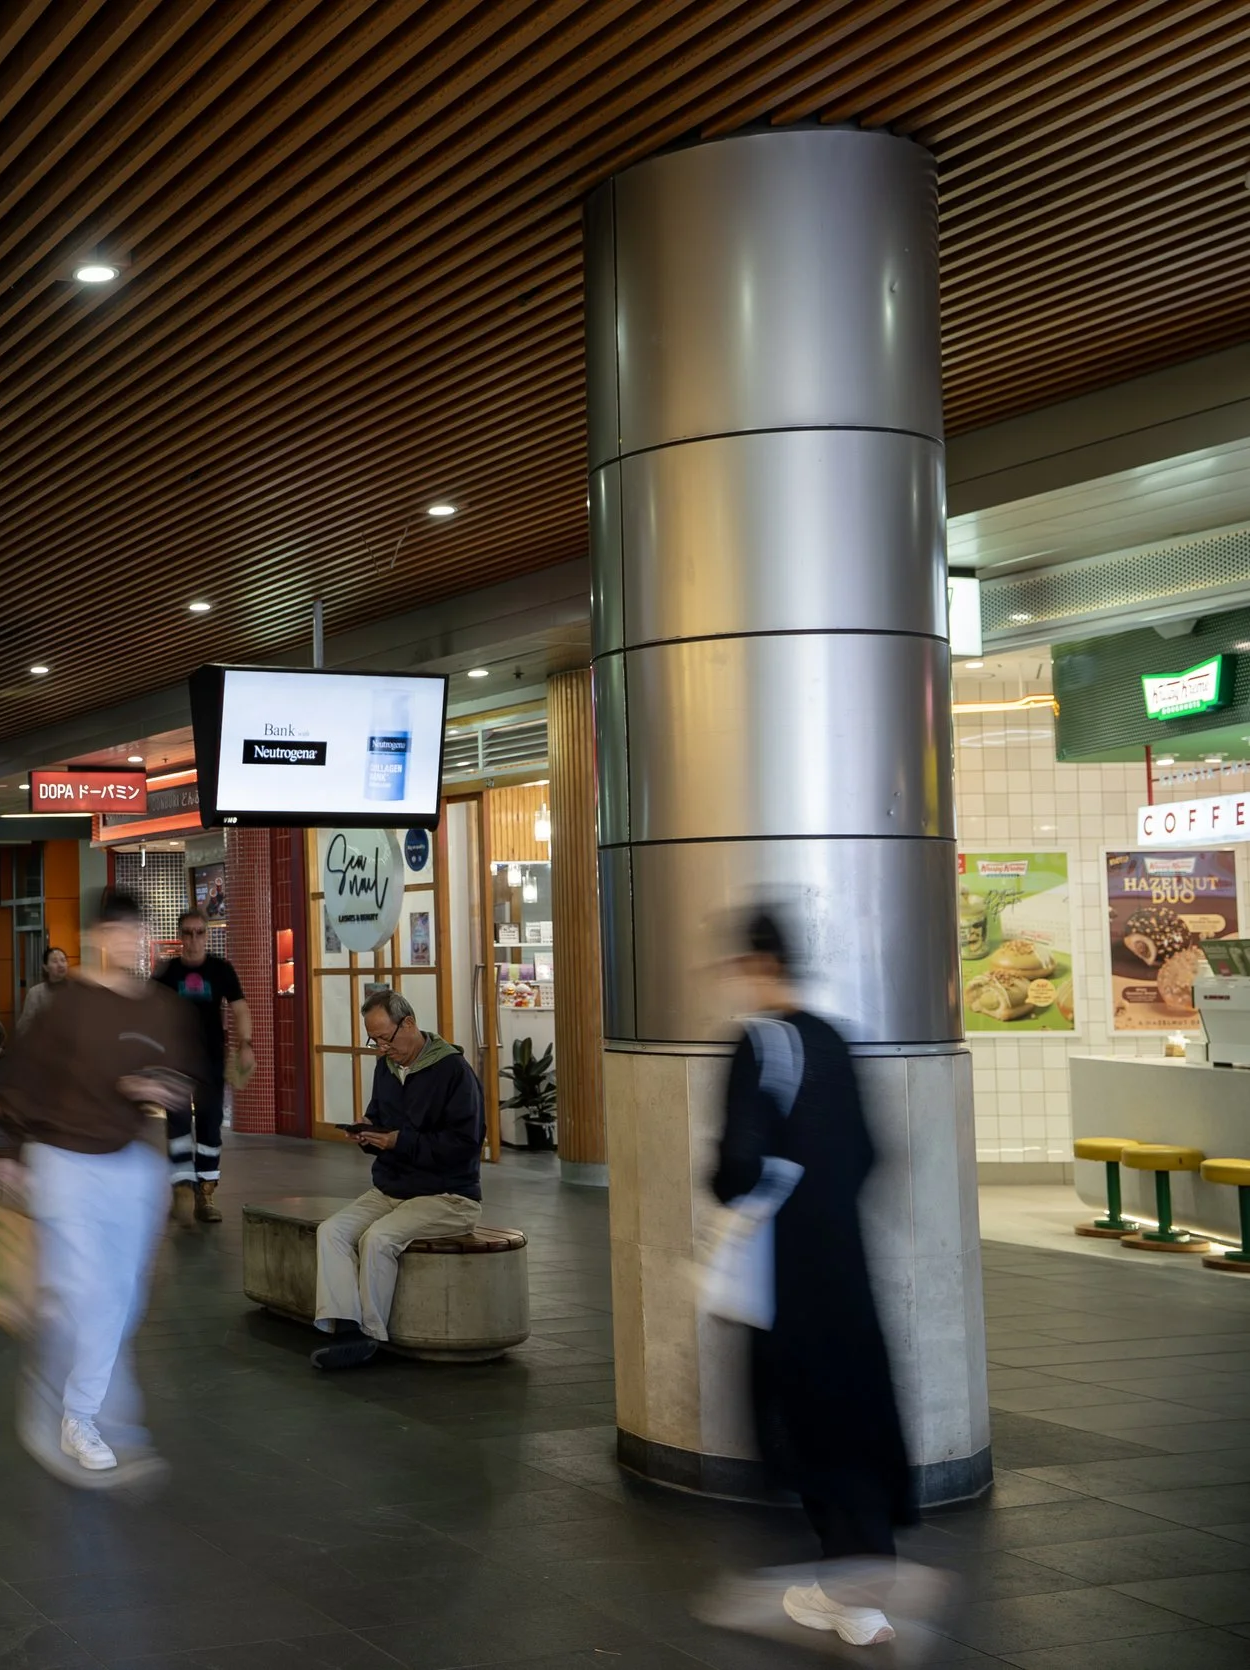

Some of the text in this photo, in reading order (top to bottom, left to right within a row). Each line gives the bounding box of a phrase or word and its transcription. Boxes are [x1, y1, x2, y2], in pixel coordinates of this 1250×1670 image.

[264, 723, 295, 736] Bank
[253, 745, 318, 762] Neutrogena
[39, 783, 140, 800] DOPA ドーパミン
[1123, 876, 1218, 892] HAZELNUT
[1152, 888, 1196, 904] DUO
